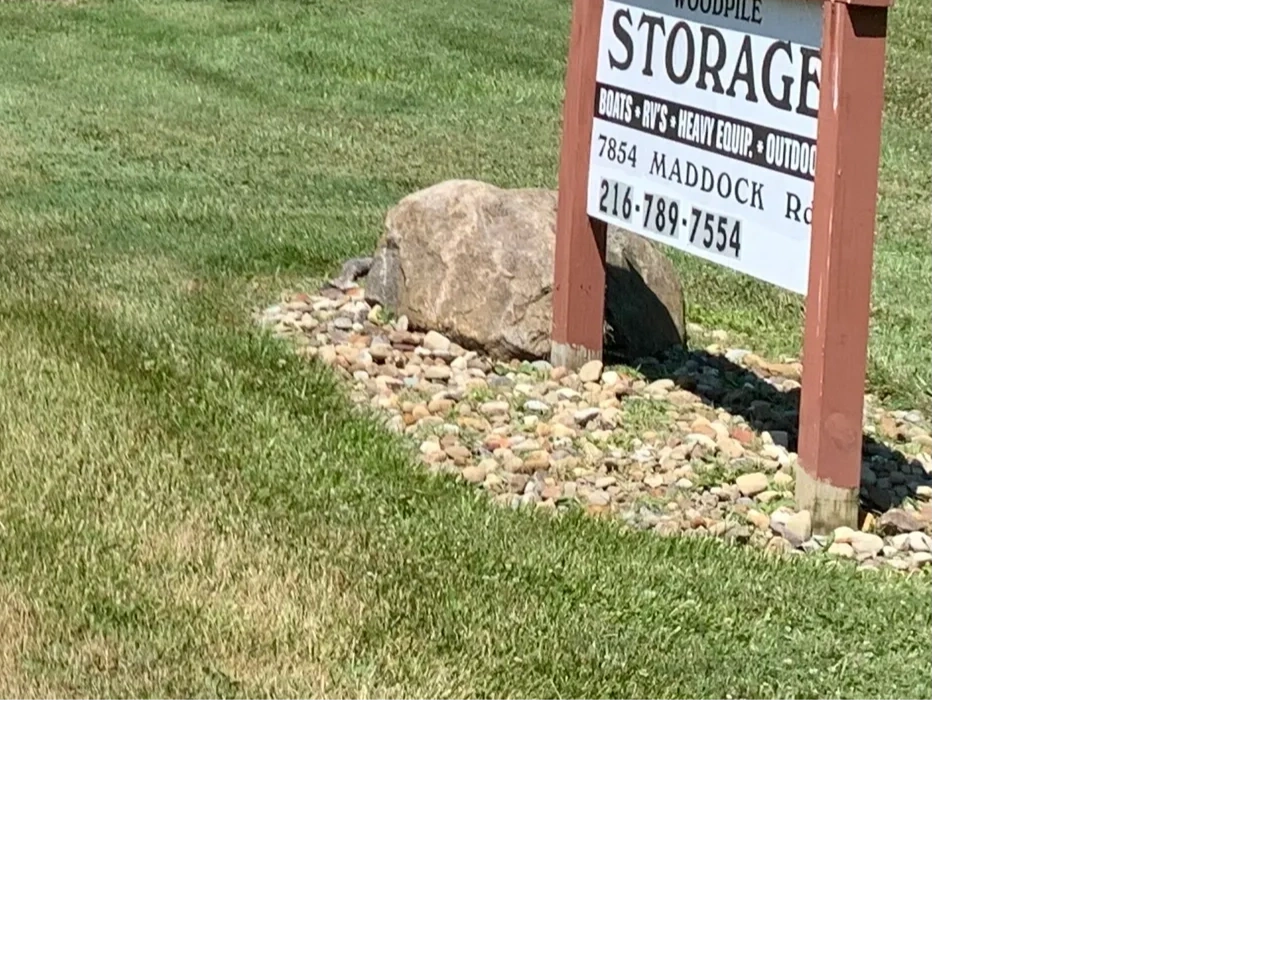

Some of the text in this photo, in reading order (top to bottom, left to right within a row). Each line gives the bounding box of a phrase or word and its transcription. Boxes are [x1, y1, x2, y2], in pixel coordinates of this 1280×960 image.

[608, 8, 821, 118] STORAGE
[599, 88, 633, 123] BOATS
[642, 99, 667, 134] RV'S
[678, 108, 714, 147] HEAVY
[716, 120, 753, 157] EQUIP.
[599, 135, 637, 168] 7854
[650, 152, 765, 210] MADDOCK
